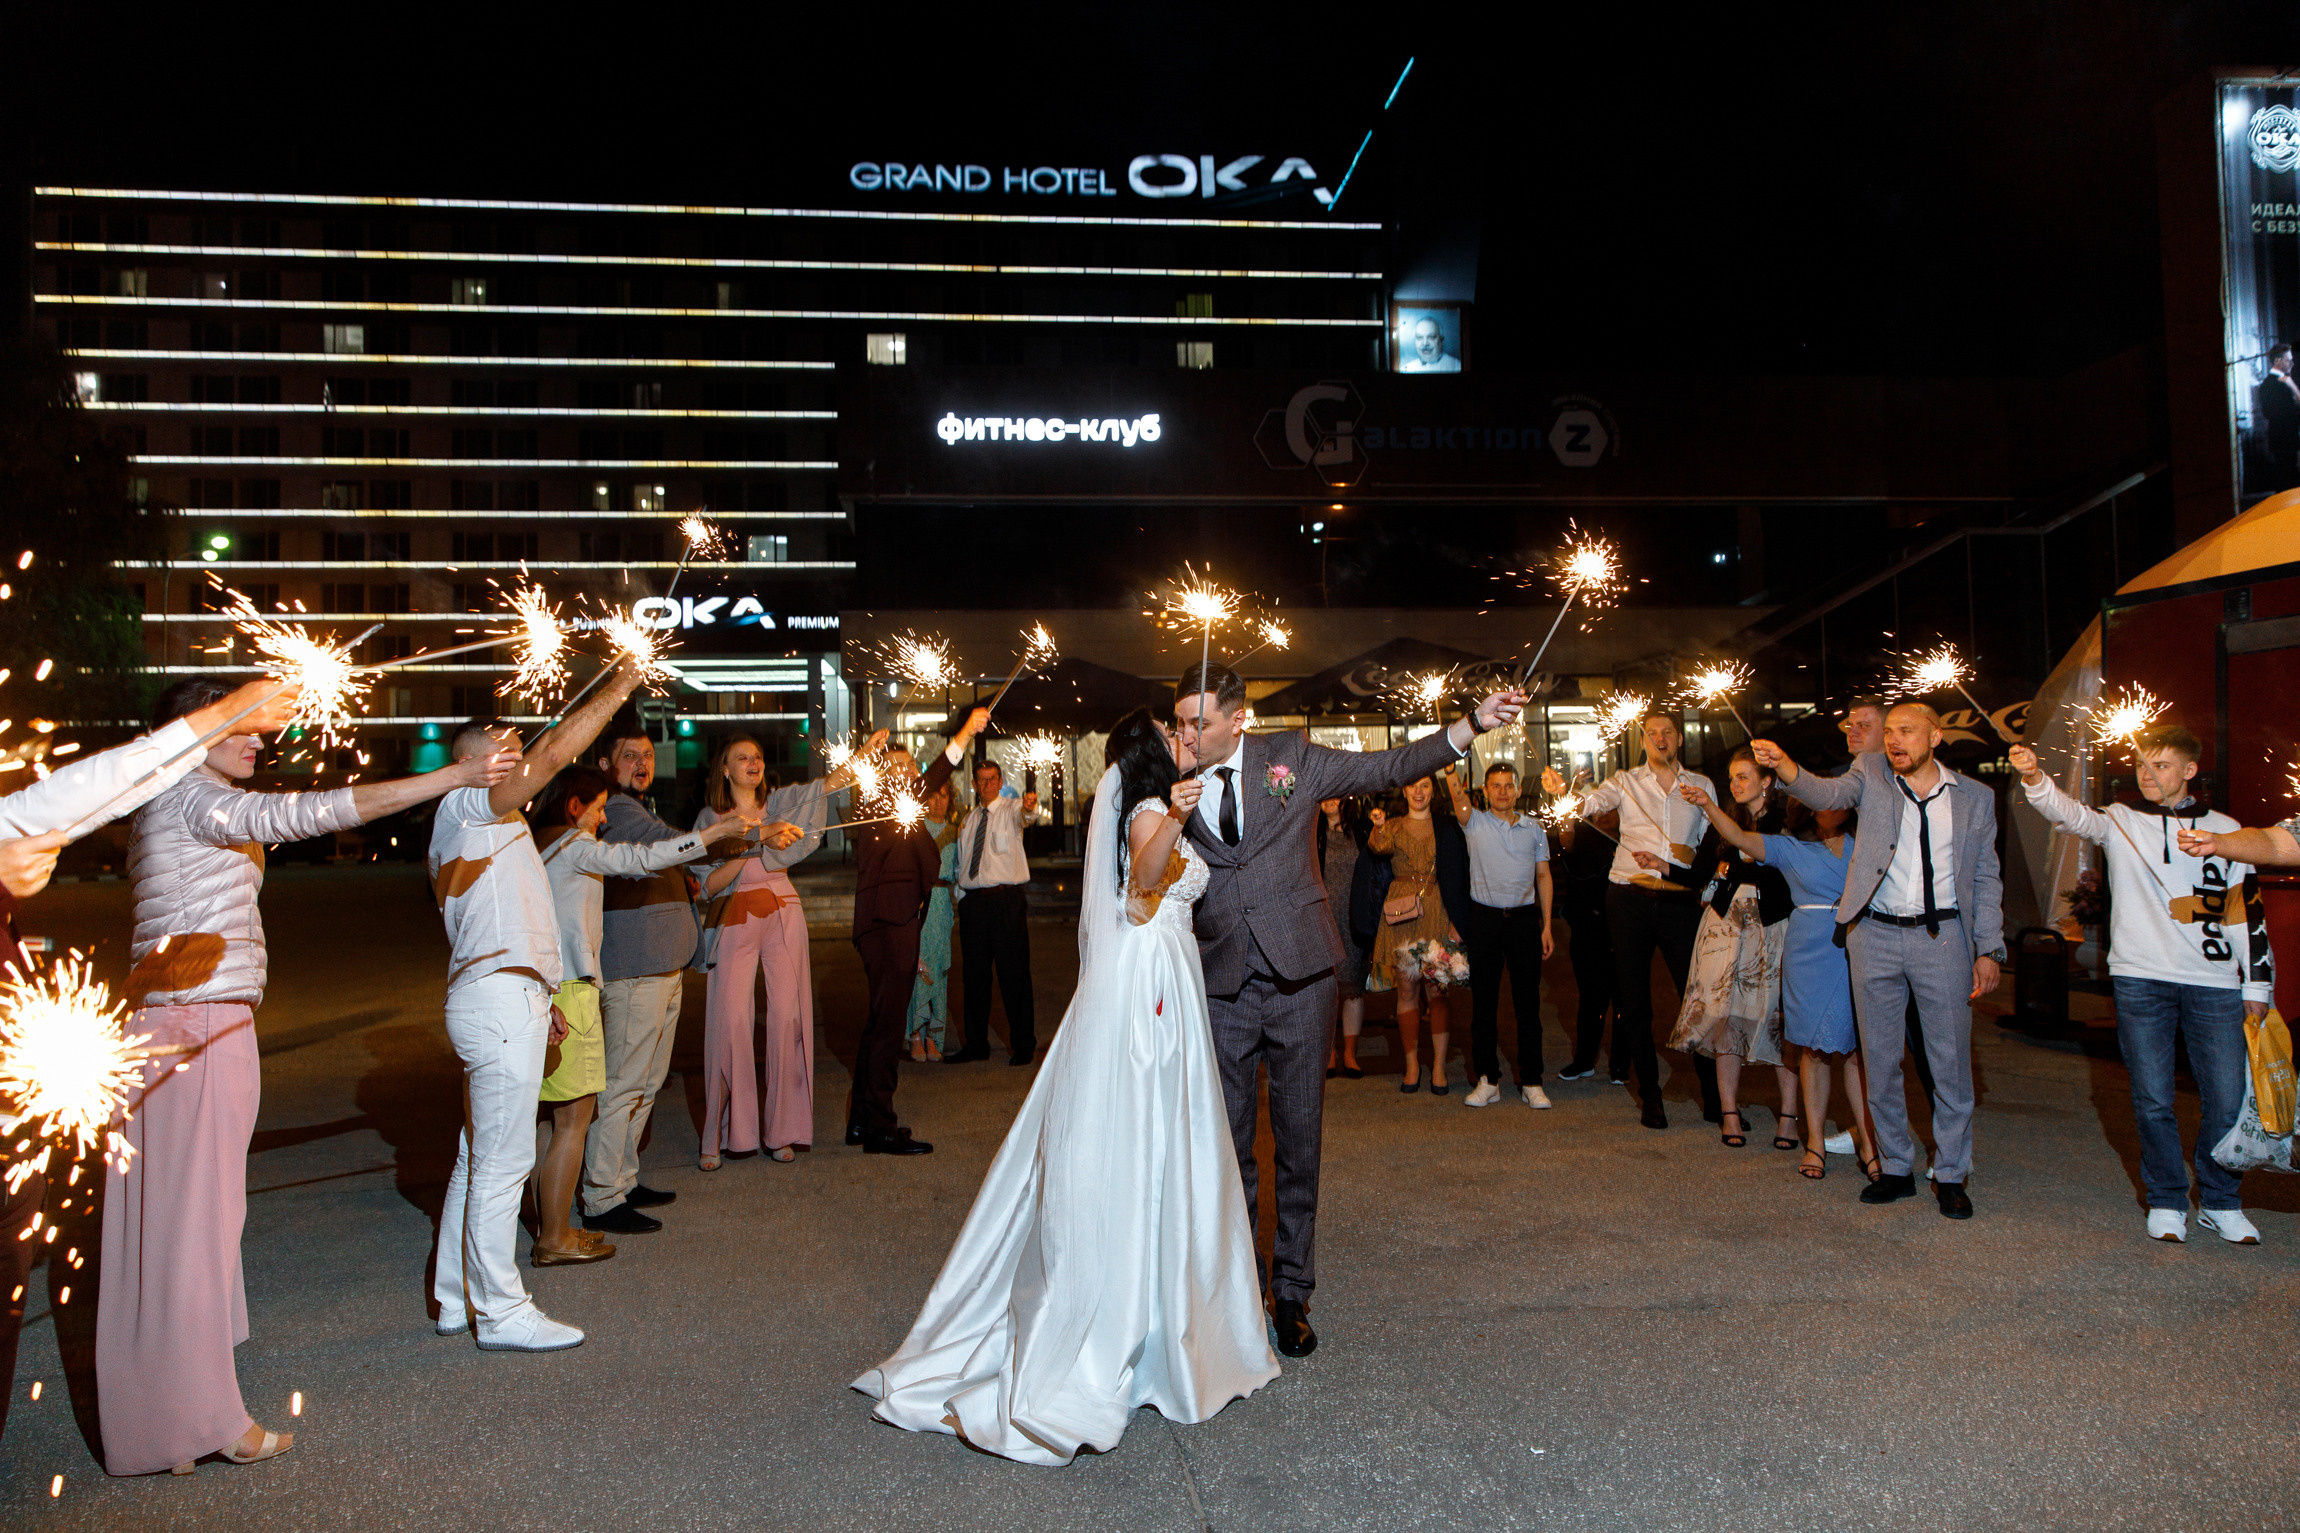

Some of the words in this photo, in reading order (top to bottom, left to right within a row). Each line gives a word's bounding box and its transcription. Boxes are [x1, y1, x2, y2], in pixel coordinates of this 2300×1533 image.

[850, 161, 991, 192] GRAND
[1003, 166, 1117, 195] HOTEL
[787, 616, 839, 629] PREMIUM
[2192, 853, 2233, 962] appa
